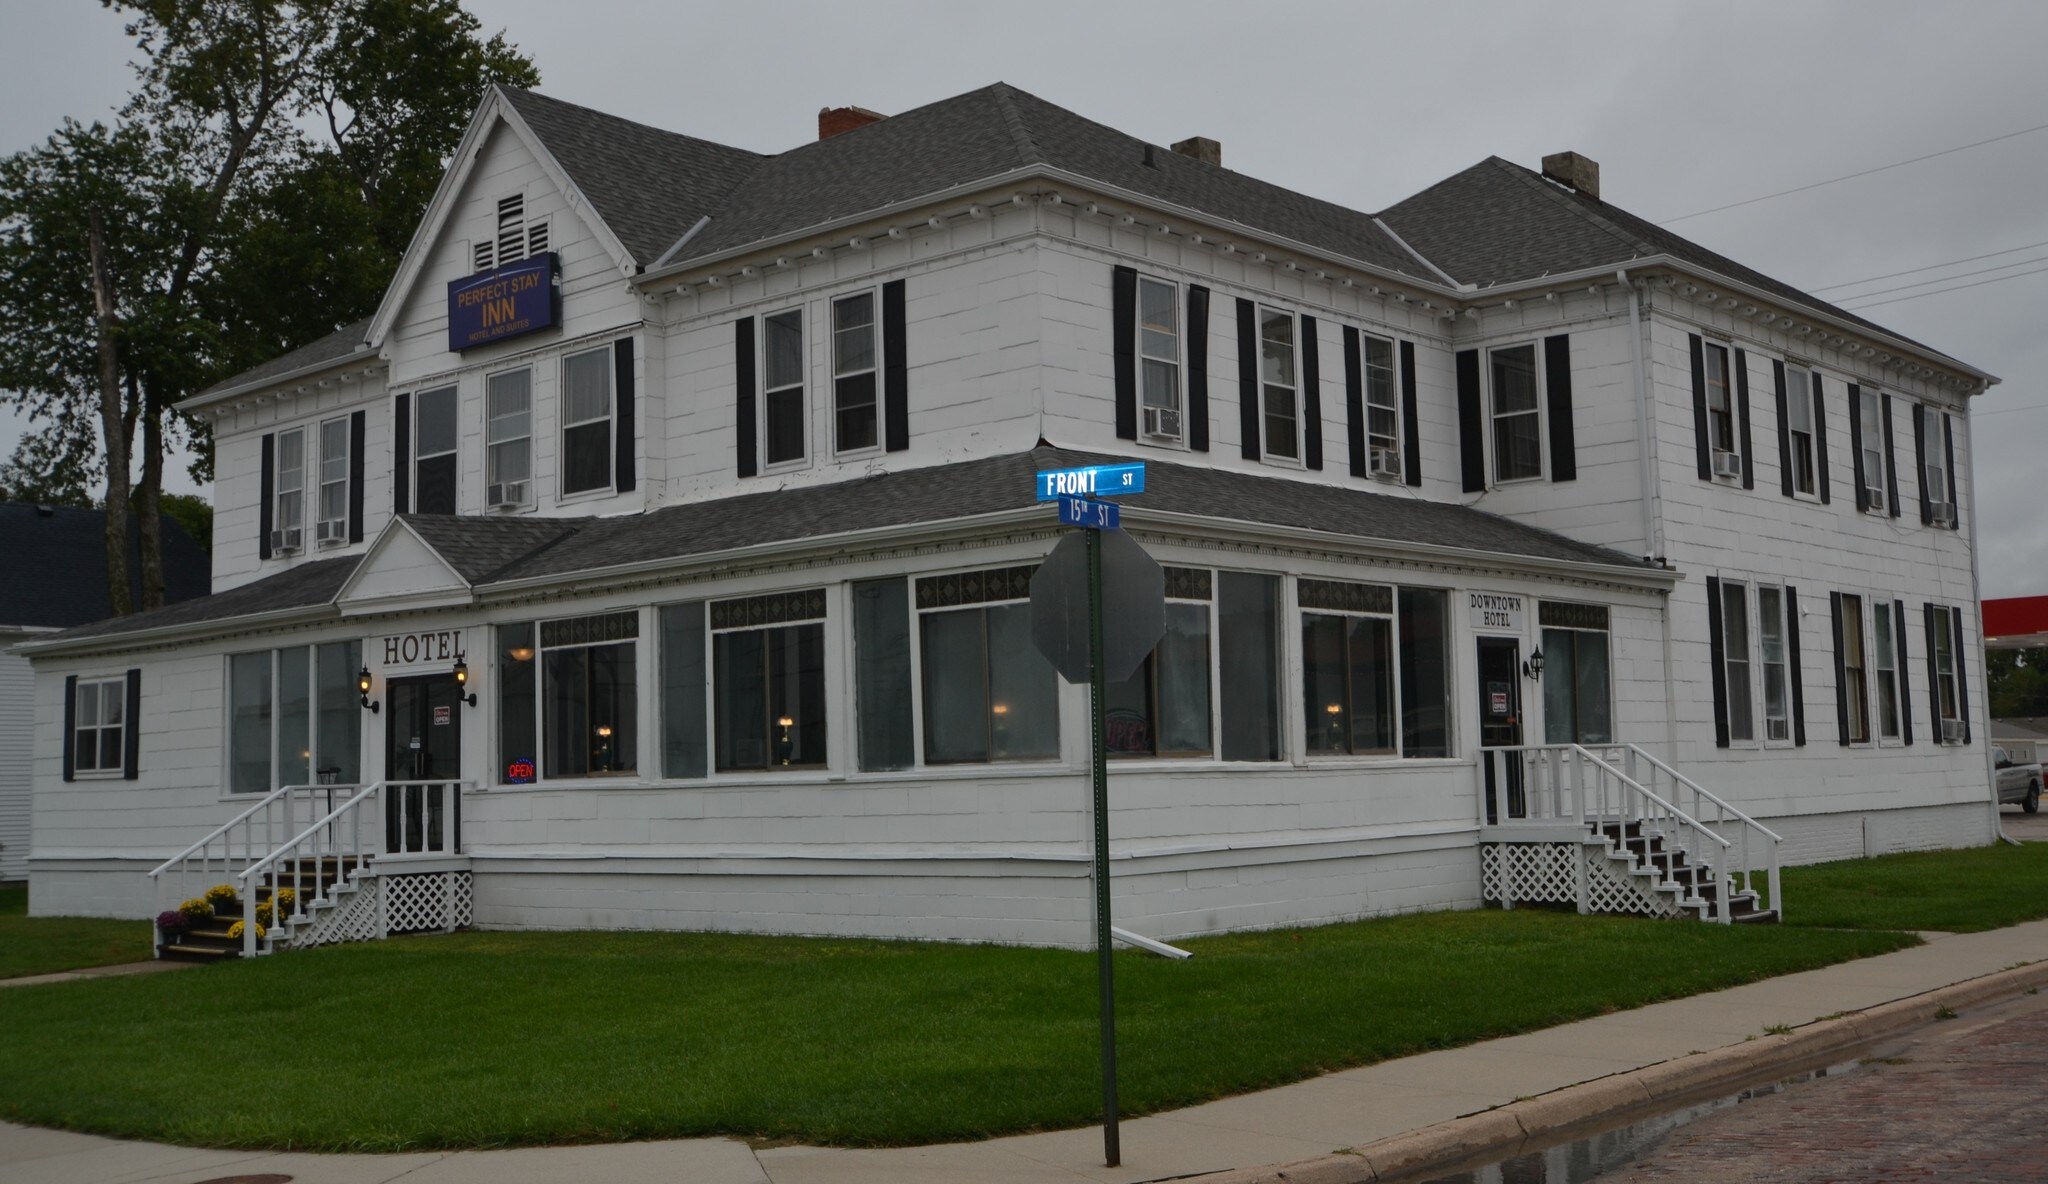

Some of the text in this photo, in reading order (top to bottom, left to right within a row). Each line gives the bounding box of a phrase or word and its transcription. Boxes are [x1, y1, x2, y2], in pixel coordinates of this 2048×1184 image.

[458, 272, 540, 308] PERFECT STAY
[482, 296, 516, 328] INN
[469, 319, 529, 341] HOTEL AND SUITES
[1047, 470, 1133, 496] FRONT ST
[1070, 499, 1109, 526] 15TH ST
[1471, 594, 1521, 612] DOWNTOWN
[1484, 611, 1510, 627] HOTEL
[383, 631, 465, 665] HOTEL
[509, 764, 533, 777] OPEN
